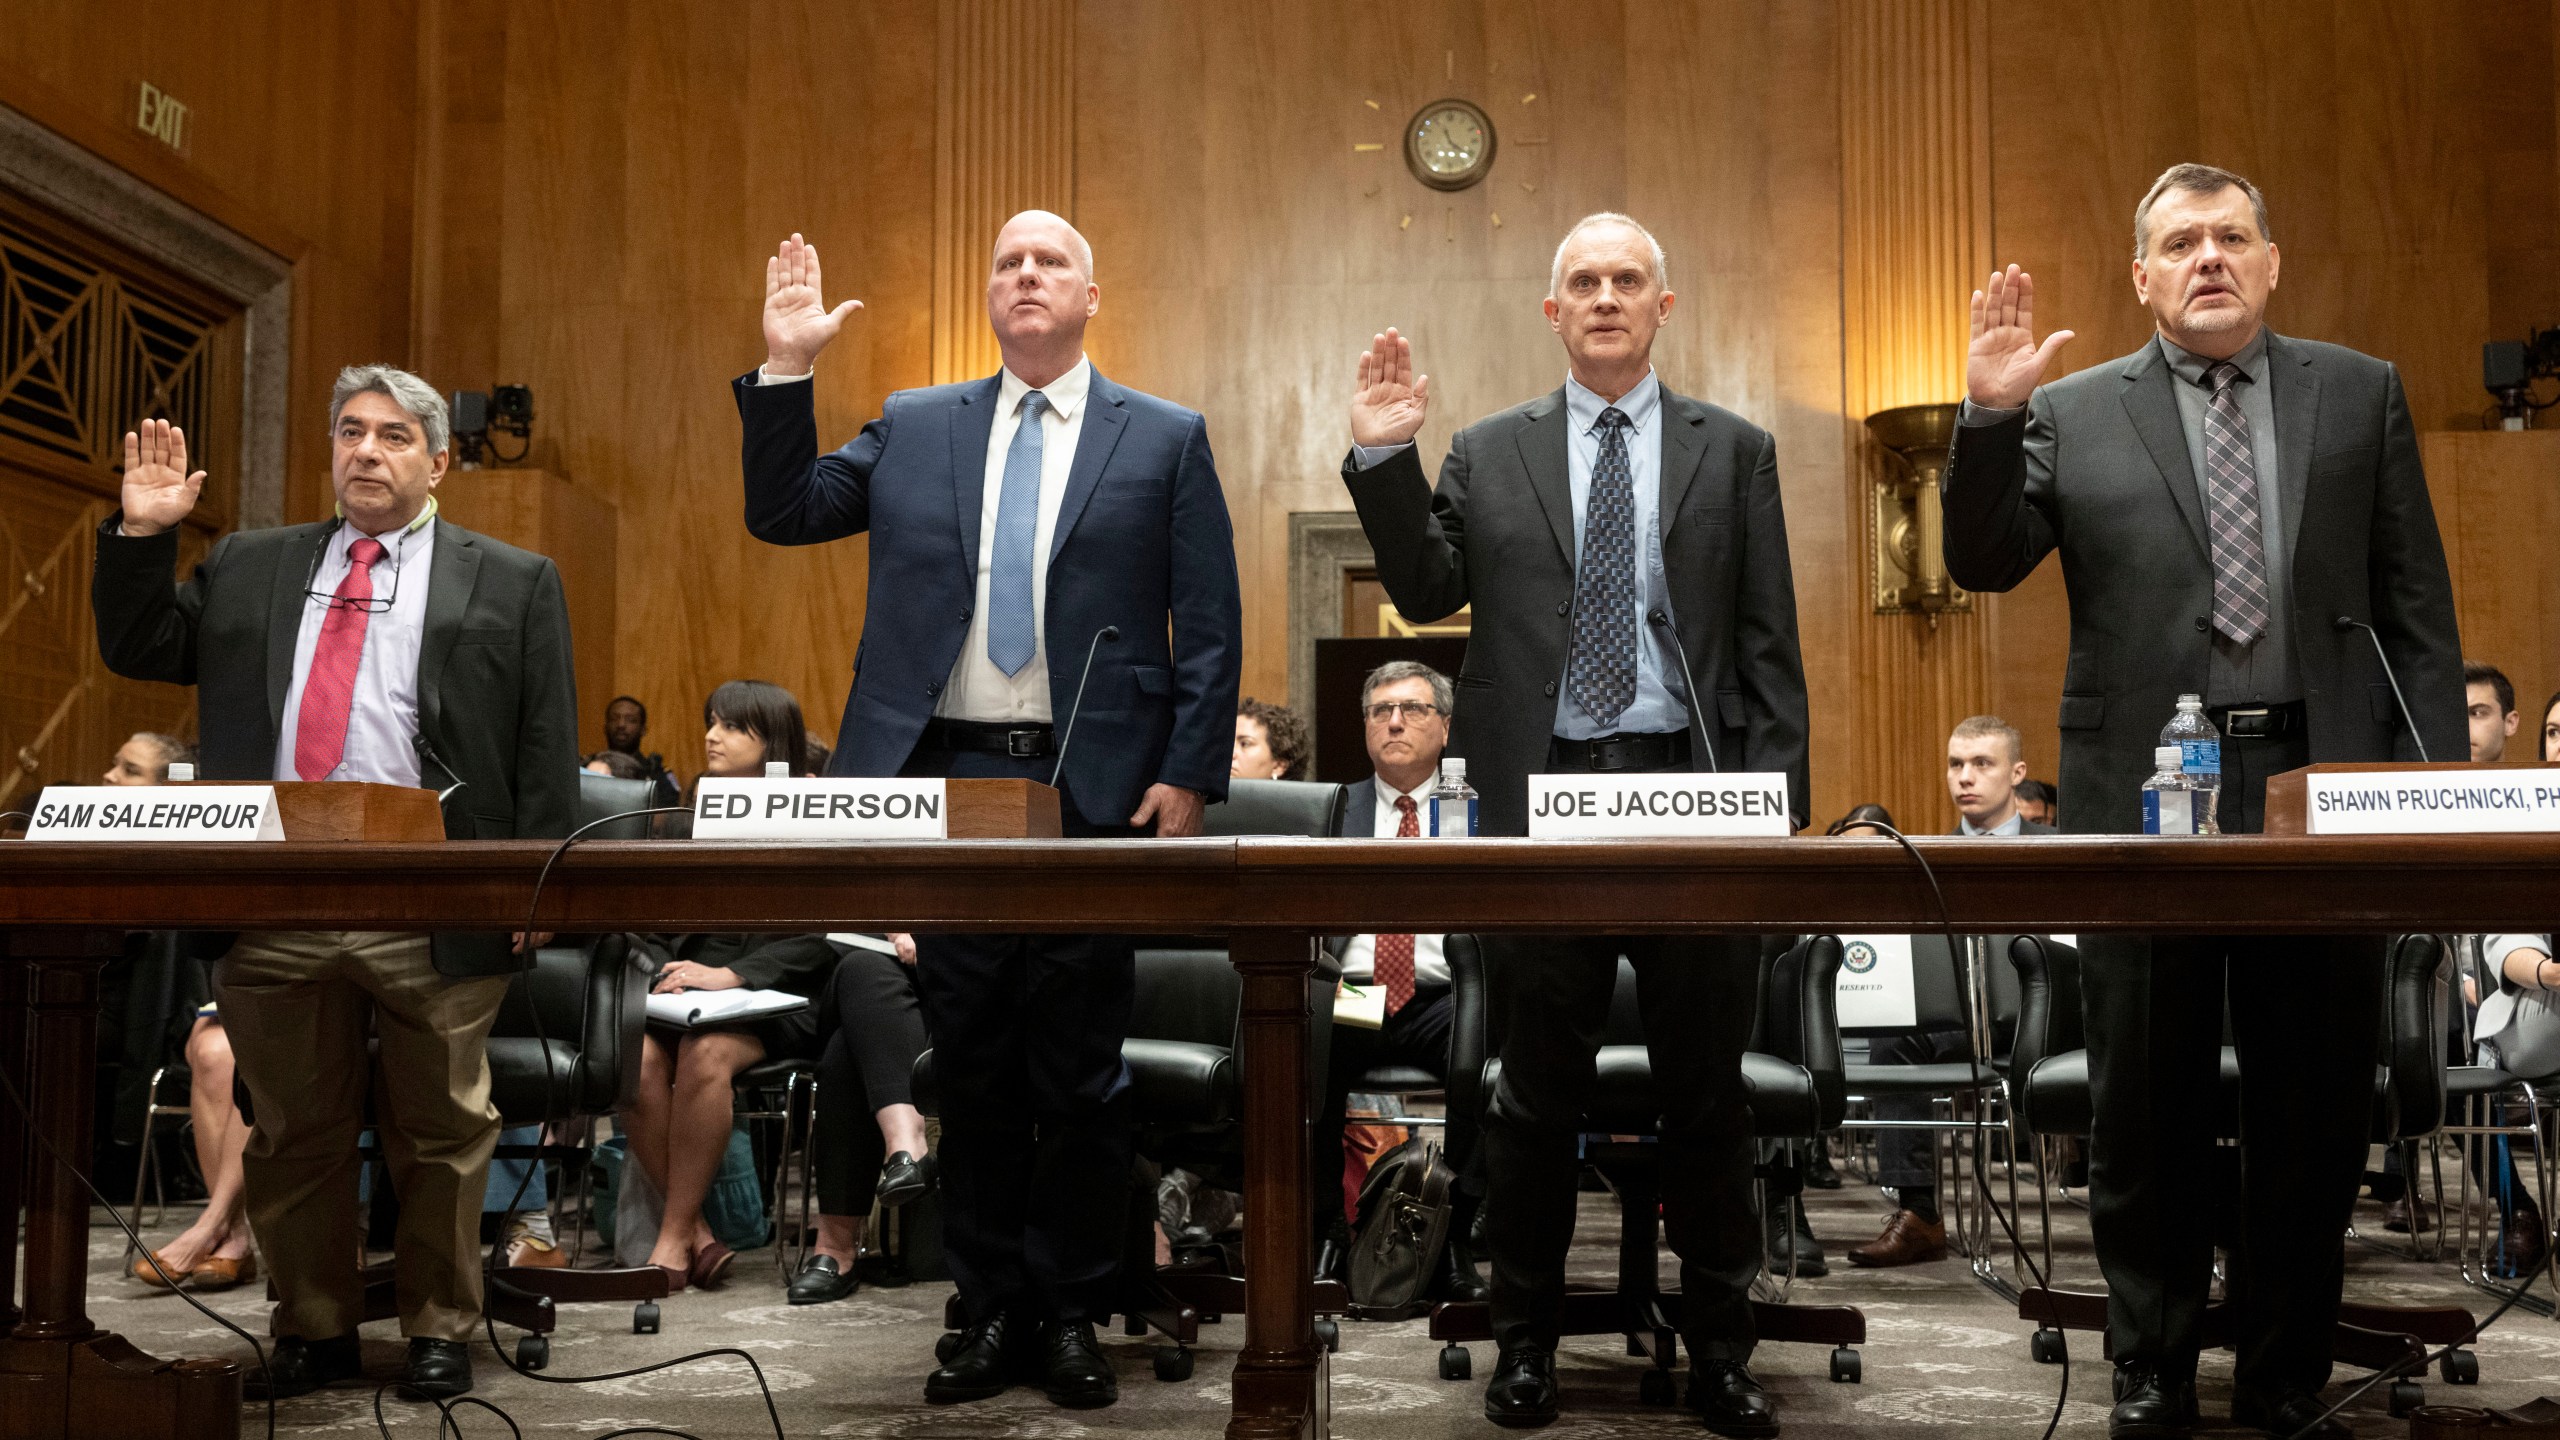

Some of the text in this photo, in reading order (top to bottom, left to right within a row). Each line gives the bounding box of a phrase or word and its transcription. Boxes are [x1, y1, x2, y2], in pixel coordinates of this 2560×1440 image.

[138, 80, 187, 150] EXIT
[699, 793, 940, 819] ED PIERSON
[1534, 790, 1783, 818] JOE JACOBSEN
[2317, 787, 2560, 812] SHAWN PRUCHNICKI, PH
[36, 803, 96, 828] SAM
[98, 803, 260, 829] SALEHPOUR
[1839, 983, 1883, 991] RESERVED
